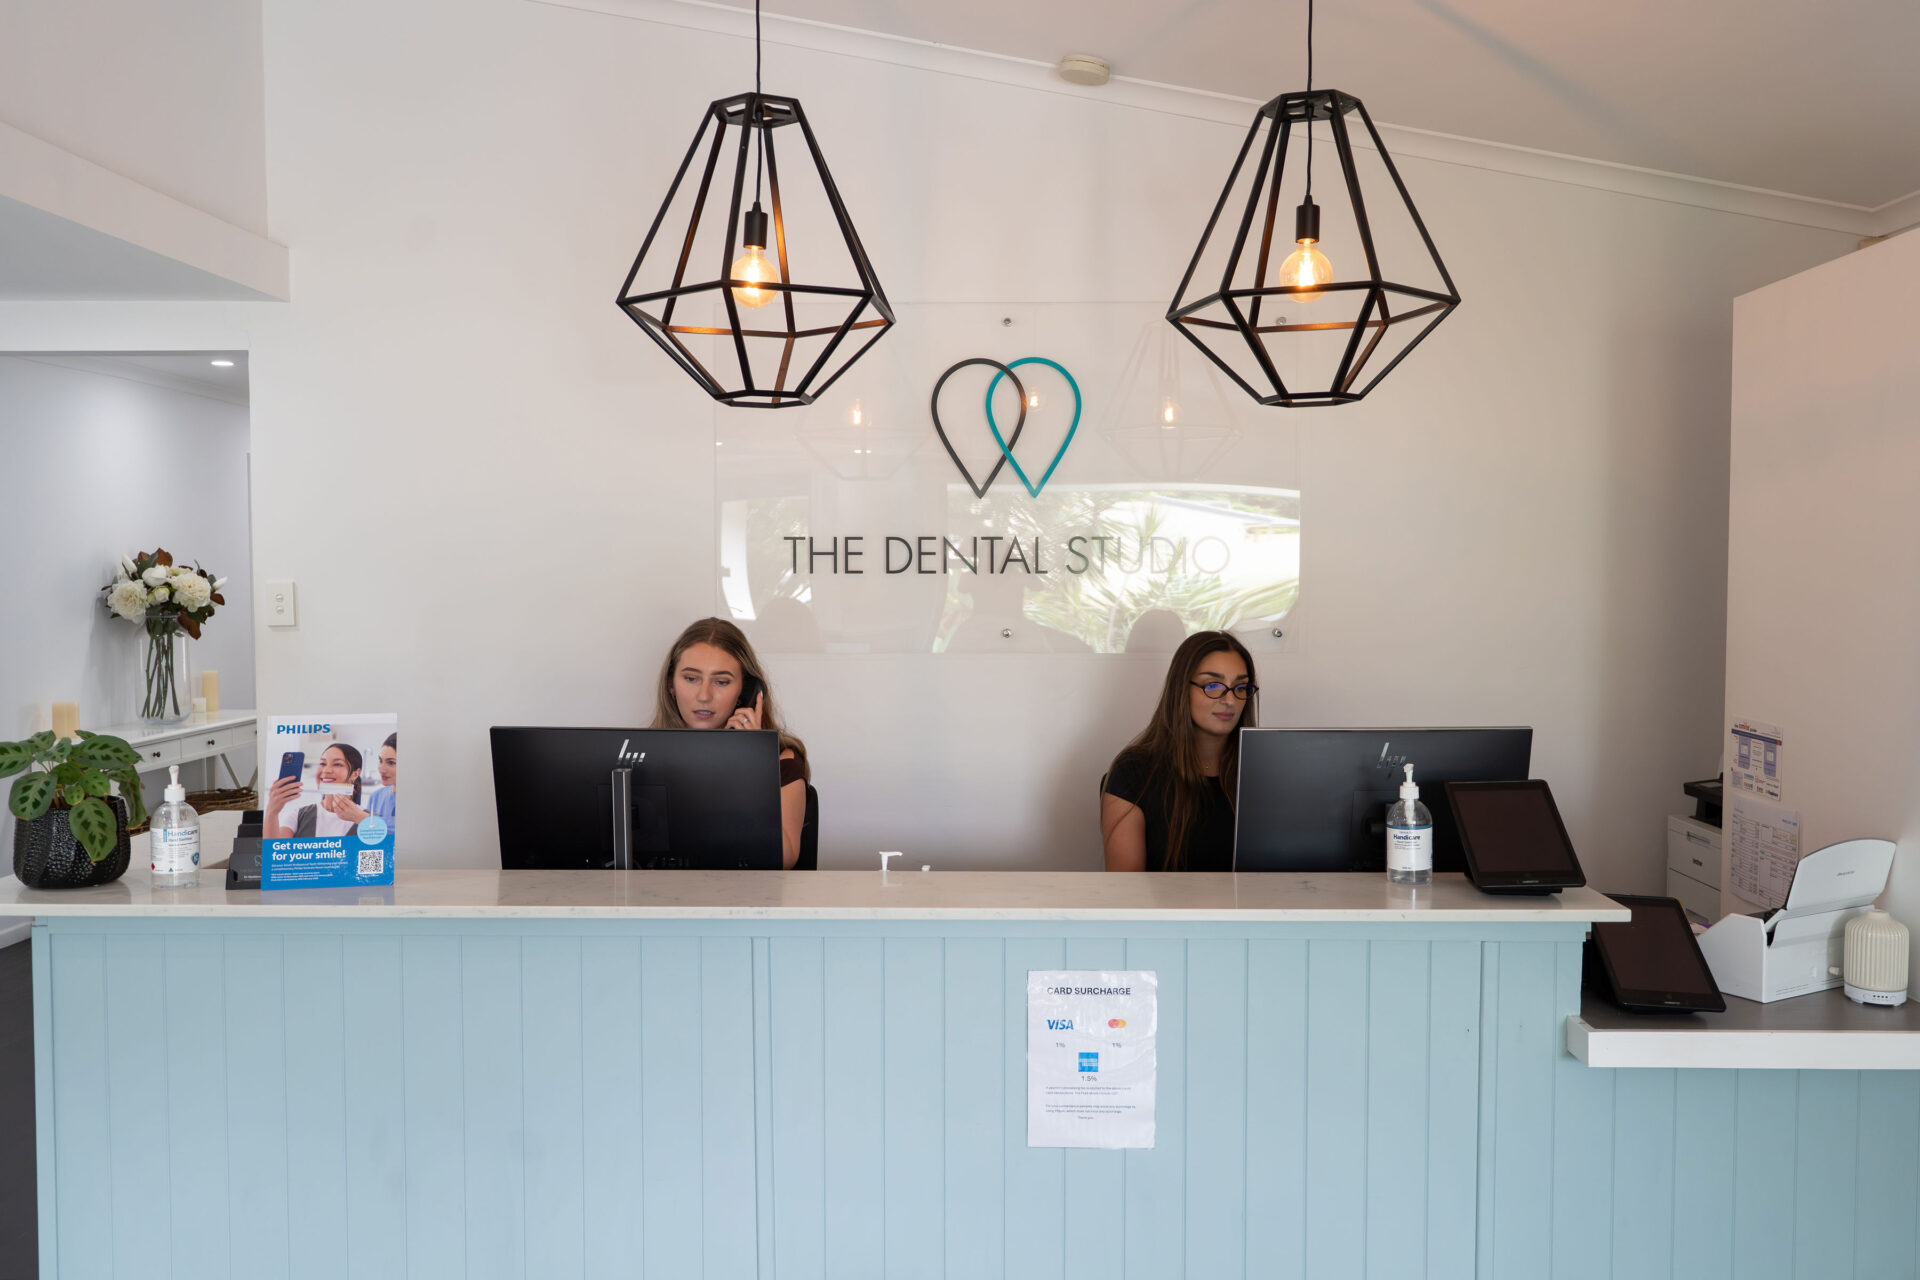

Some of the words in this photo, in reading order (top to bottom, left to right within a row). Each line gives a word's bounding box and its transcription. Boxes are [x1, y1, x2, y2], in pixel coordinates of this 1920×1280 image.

[783, 536, 864, 575] THE
[884, 536, 1049, 575] DENTAL
[1065, 536, 1231, 575] STUDIO
[276, 723, 332, 735] PHILIPS
[272, 841, 291, 851] Get
[293, 839, 342, 850] rewarded
[271, 851, 288, 861] for
[289, 852, 313, 863] your
[315, 849, 347, 859] smile!
[1047, 987, 1073, 995] CARD
[1074, 987, 1131, 996] SURCHARGE
[1047, 1019, 1074, 1030] VISA
